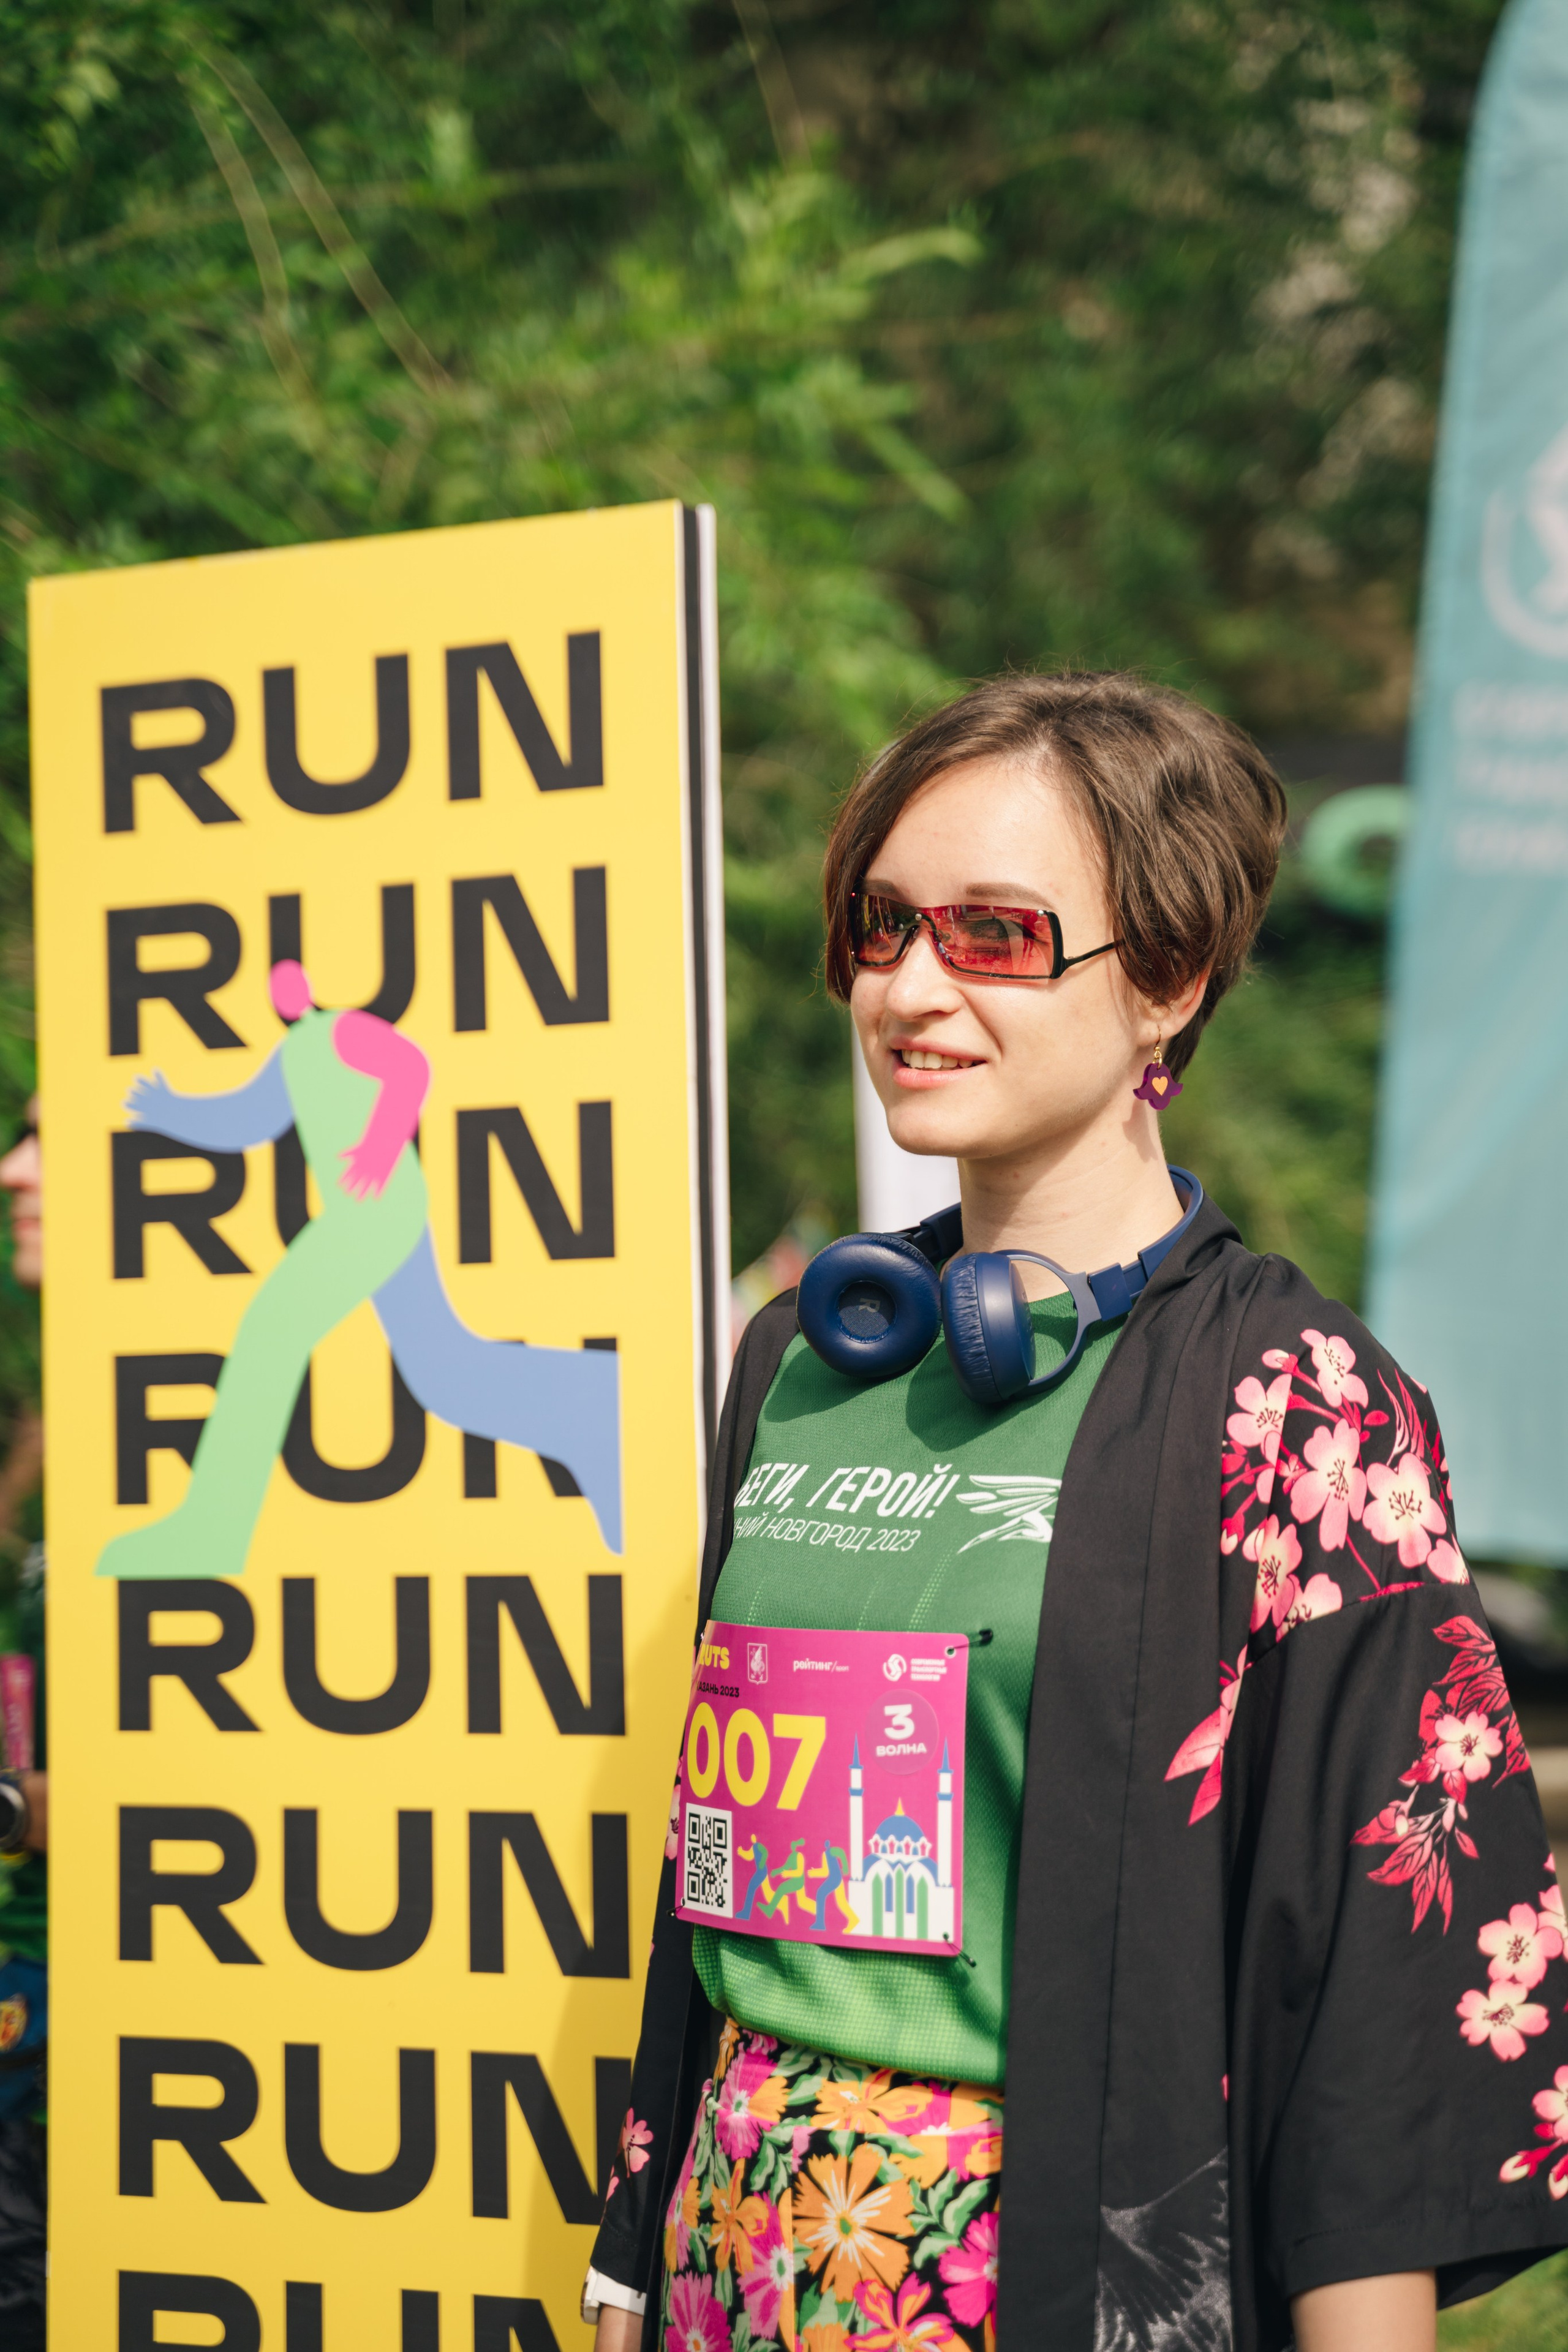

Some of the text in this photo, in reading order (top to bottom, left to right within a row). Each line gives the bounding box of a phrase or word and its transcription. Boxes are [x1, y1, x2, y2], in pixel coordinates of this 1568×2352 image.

[99, 628, 605, 834] RUN
[105, 864, 611, 1057] RUN
[858, 1297, 881, 1313] R
[734, 1463, 960, 1519] БЕГИ, ГЕРОЙ!
[760, 1517, 872, 1553] НОВГОРОД
[866, 1528, 921, 1552] 2023
[117, 1573, 627, 1736] RUN
[720, 1684, 740, 1698] 2023
[687, 1702, 826, 1811] 007
[876, 1742, 927, 1757] ВОЛНА
[884, 1703, 915, 1740] 3
[118, 1804, 631, 1980] RUN
[118, 2034, 633, 2226] RUN
